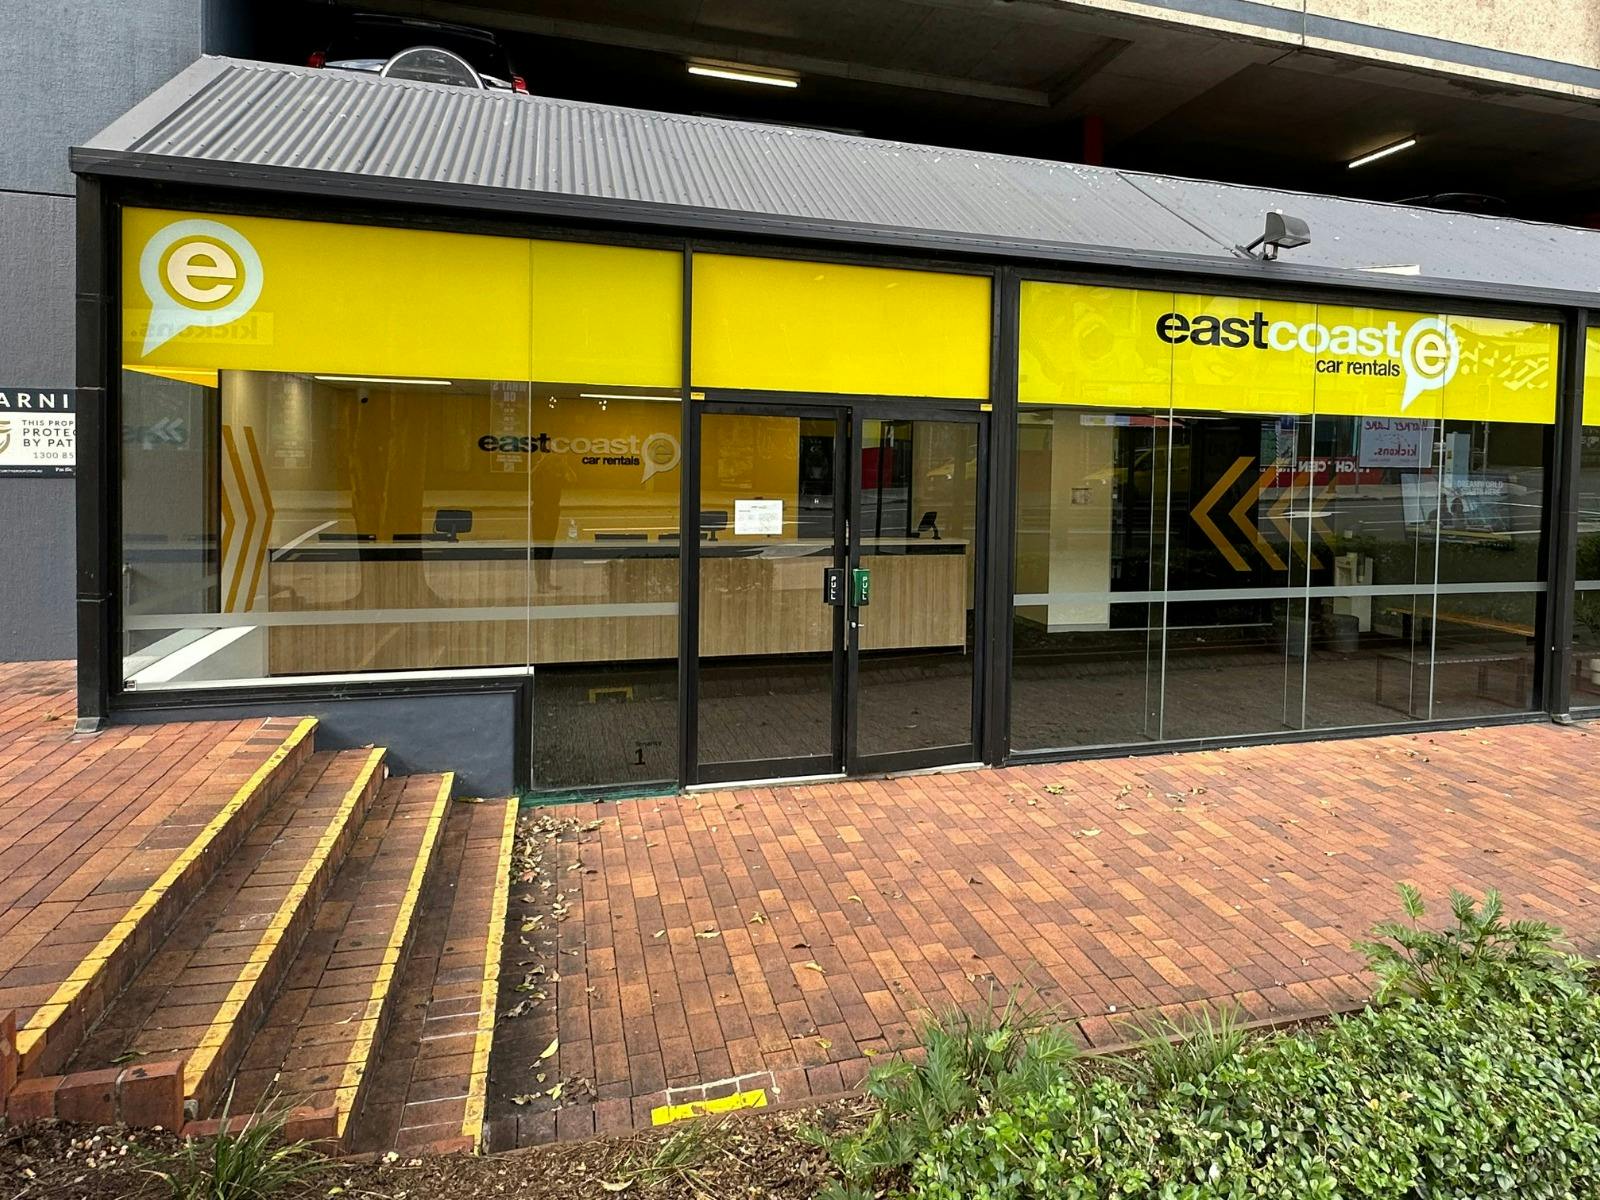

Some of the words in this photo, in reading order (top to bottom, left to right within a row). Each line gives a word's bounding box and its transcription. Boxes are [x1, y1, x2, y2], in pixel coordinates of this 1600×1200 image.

[166, 241, 237, 303] e
[1156, 311, 1402, 358] eastcoast
[1316, 358, 1343, 374] car
[1346, 359, 1401, 377] rentals
[0, 392, 69, 409] ARNI
[23, 439, 41, 447] BY
[47, 439, 73, 447] PAT
[477, 432, 641, 455] eastcoast
[582, 457, 600, 465] car
[602, 456, 641, 466] rentals
